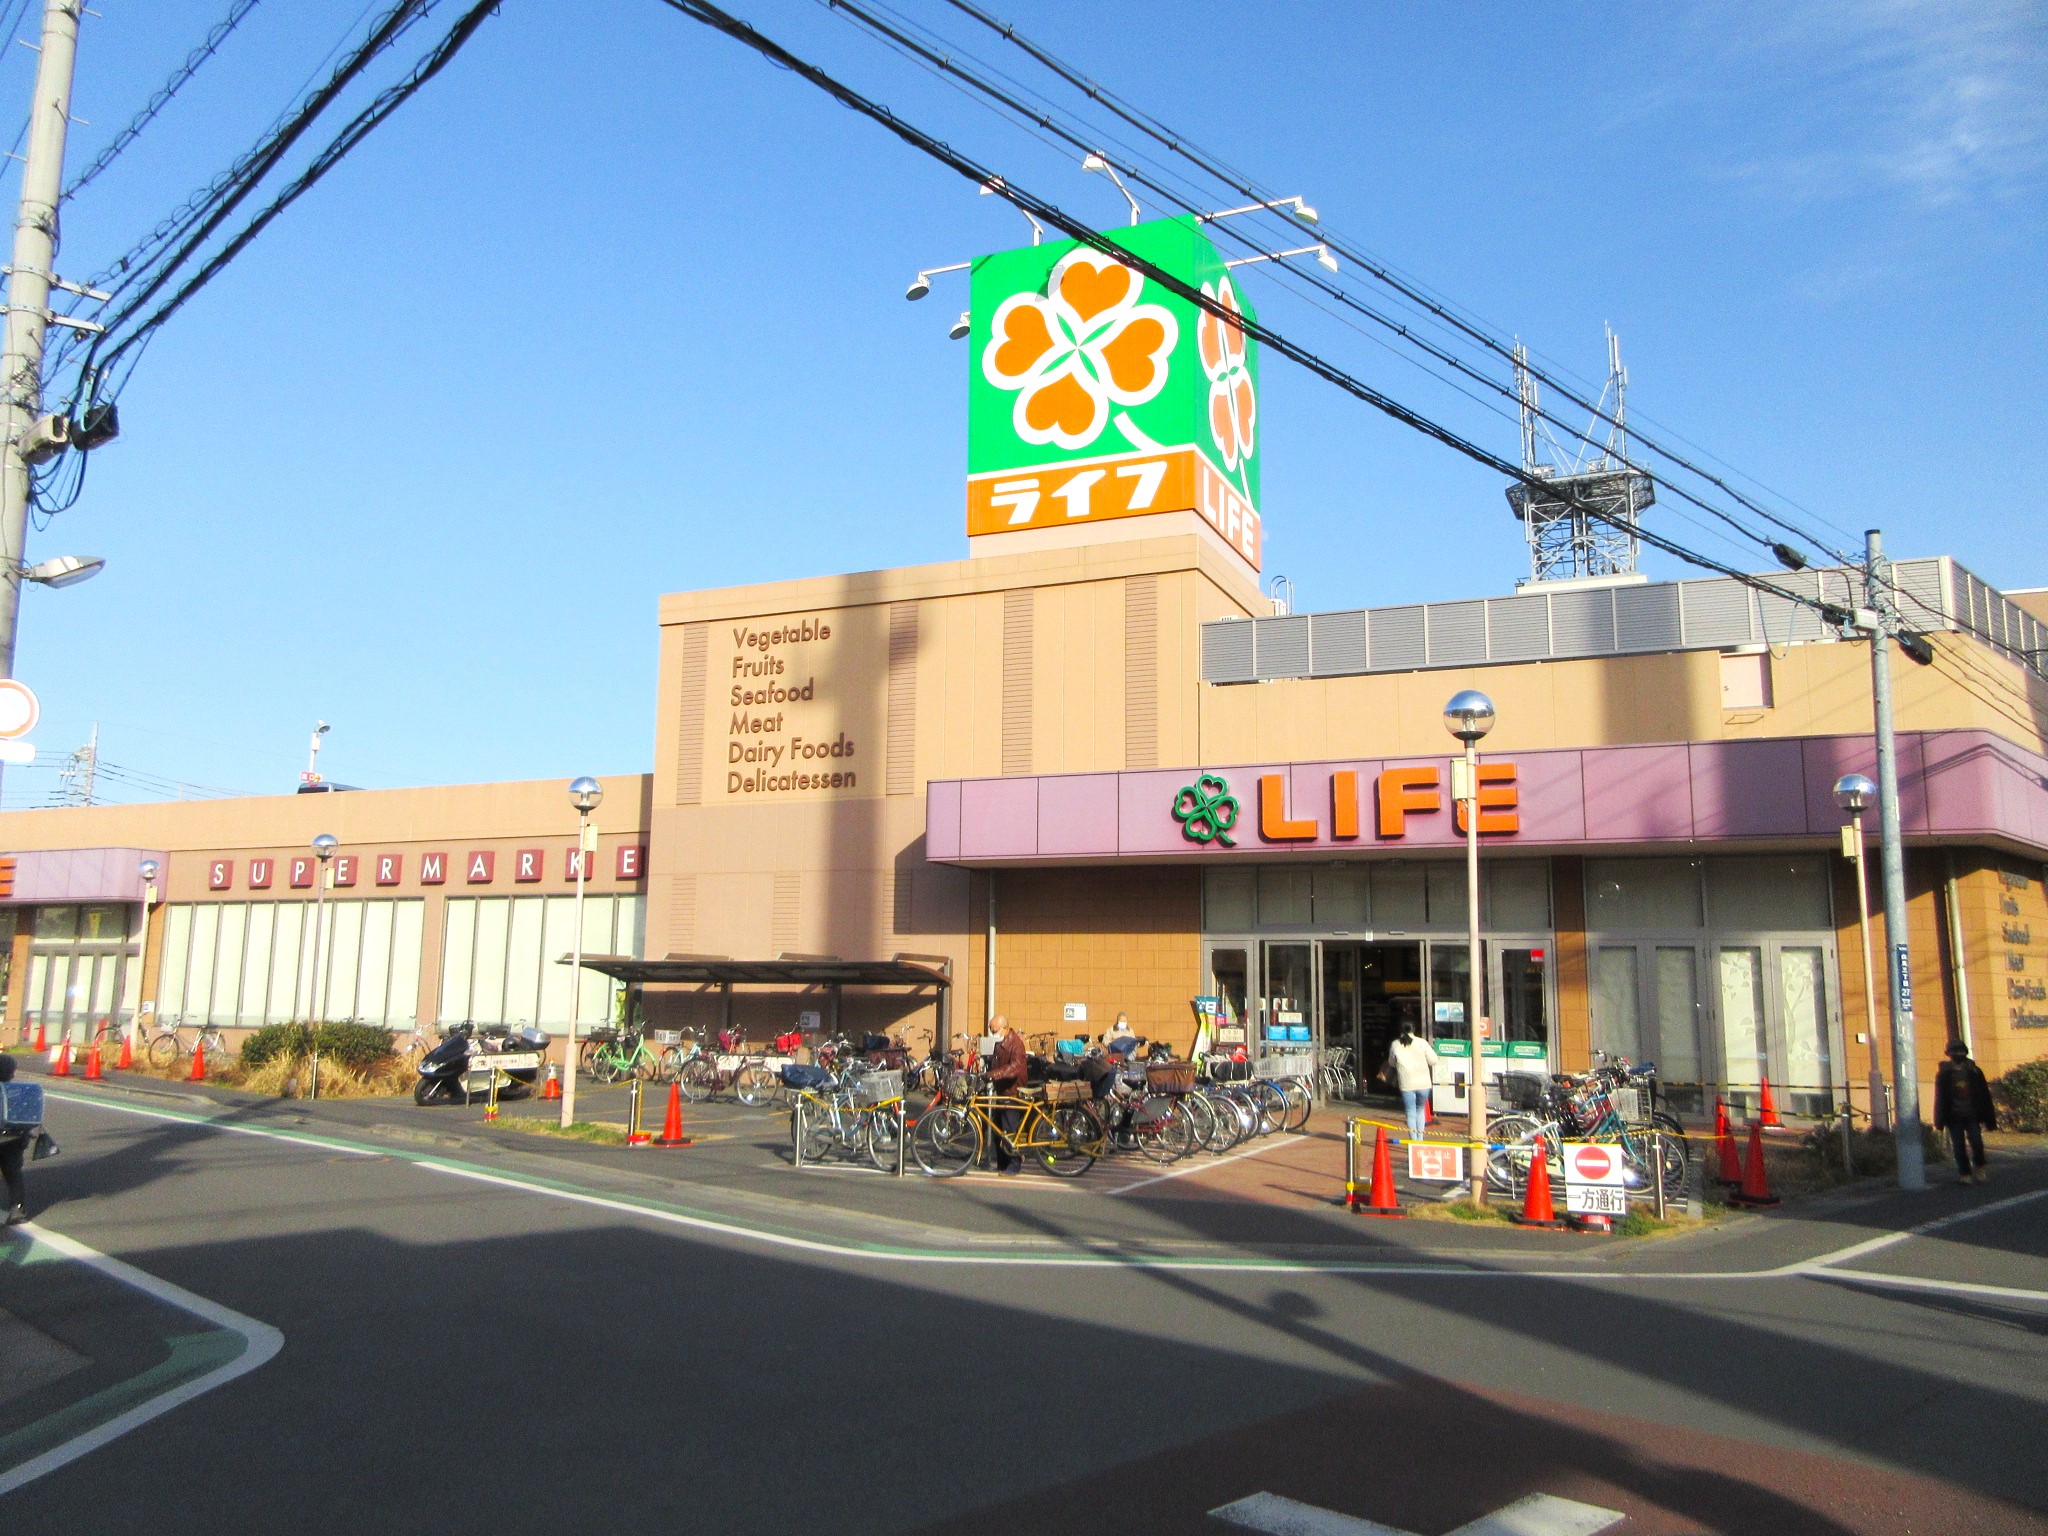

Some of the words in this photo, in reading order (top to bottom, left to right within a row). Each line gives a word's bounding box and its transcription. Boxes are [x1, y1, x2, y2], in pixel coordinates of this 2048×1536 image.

[990, 460, 1168, 525] ライフ
[1202, 465, 1255, 562] LIFE
[732, 617, 832, 652] Vegetable
[732, 653, 785, 678] Fruits
[730, 676, 814, 707] Seafood
[729, 710, 784, 735] Meat
[728, 739, 786, 768] Dairy
[790, 731, 855, 760] Foods
[727, 767, 856, 794] Delicatessen
[1258, 762, 1520, 839] LIFE
[1567, 1187, 1624, 1212] 一方通行
